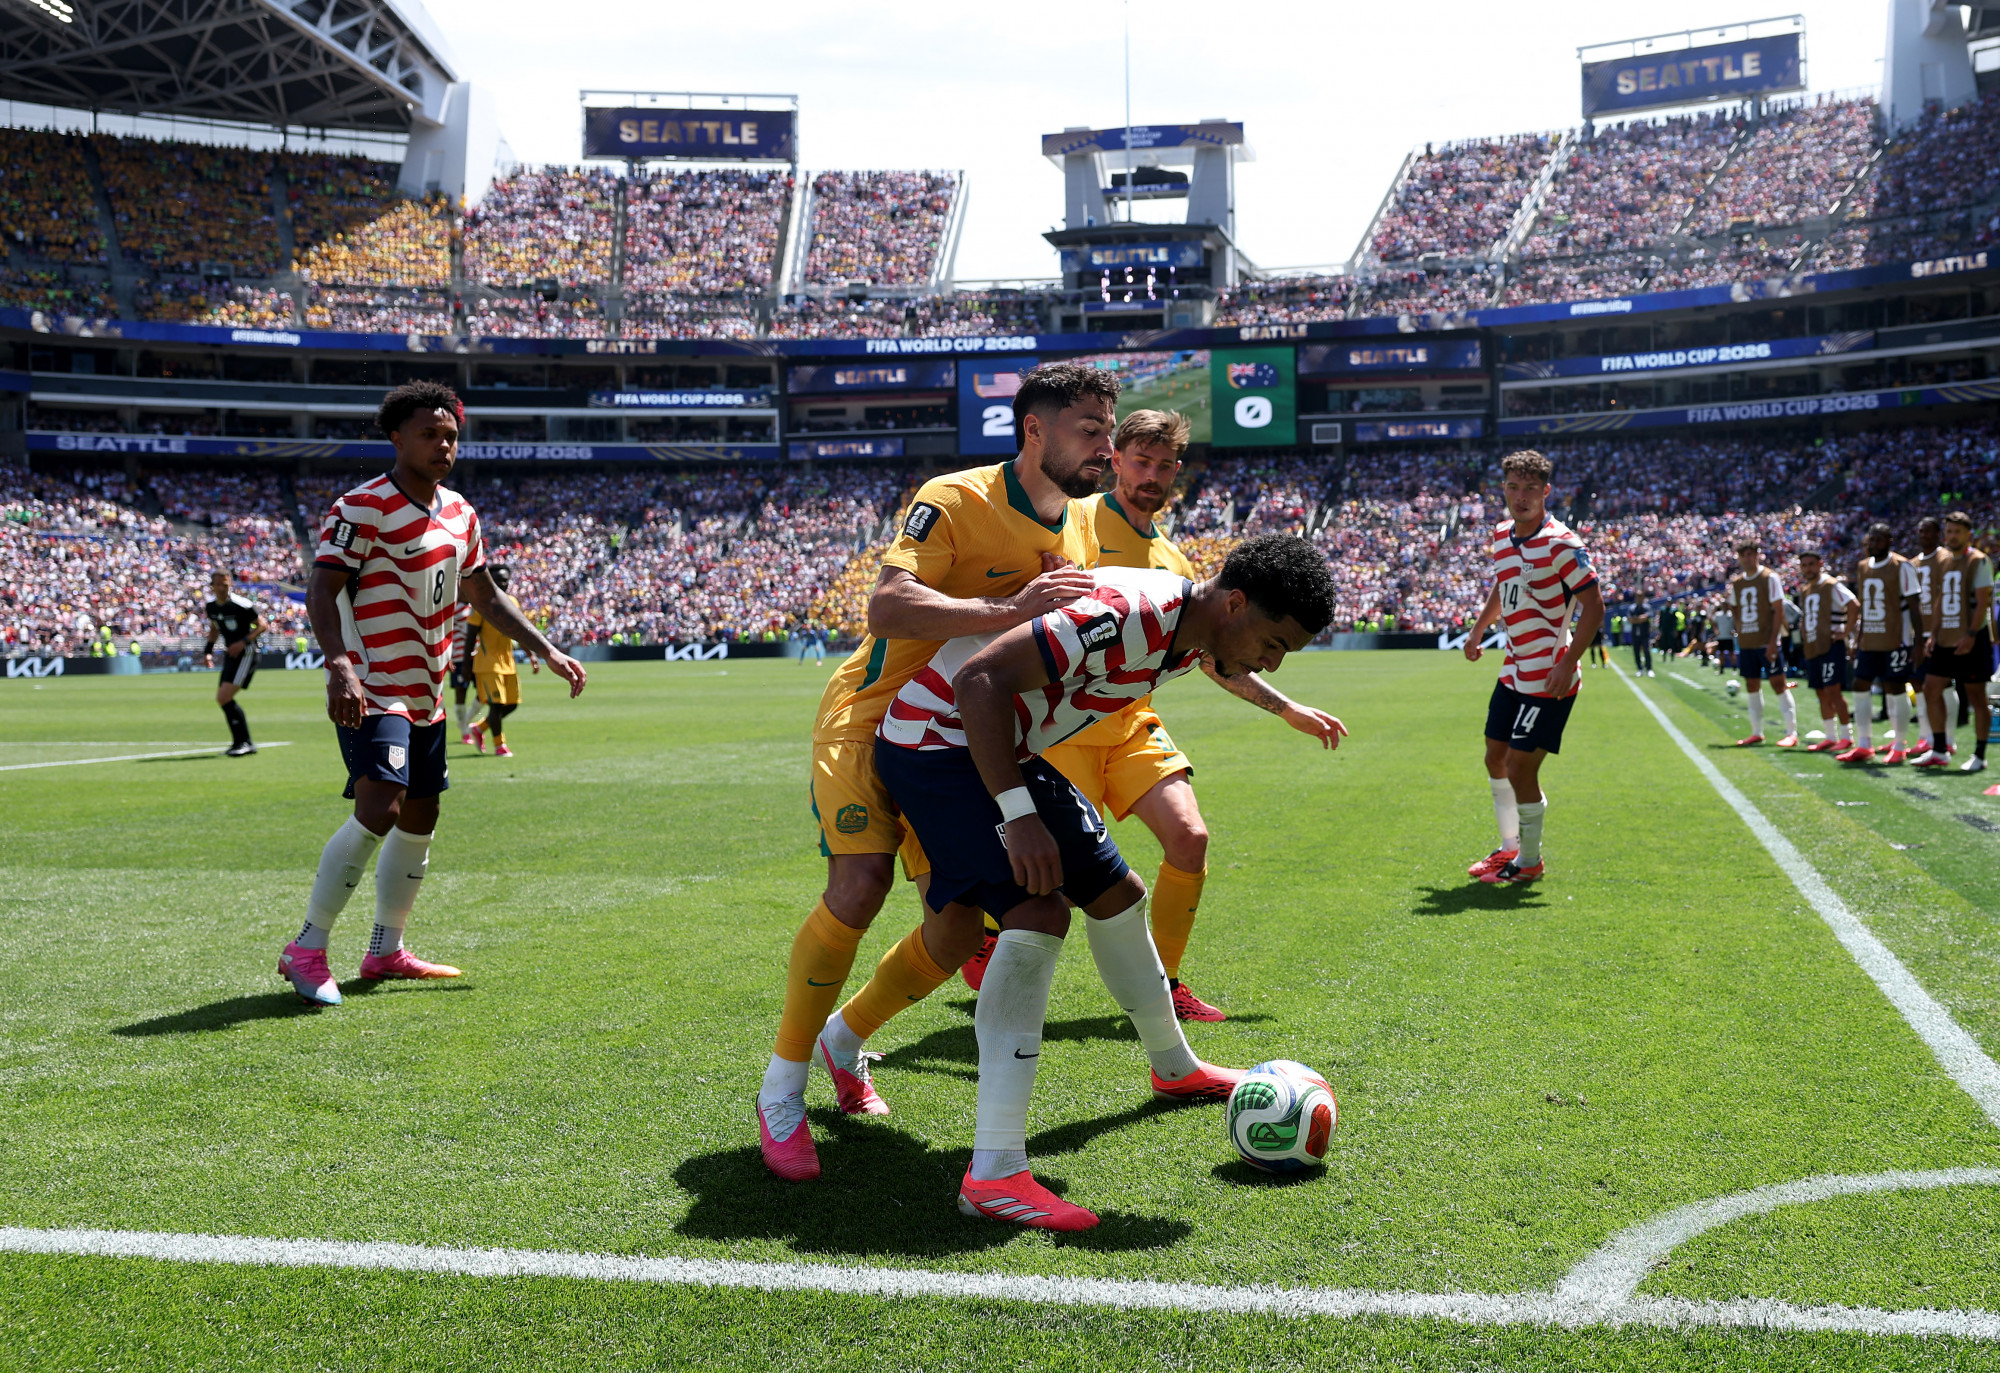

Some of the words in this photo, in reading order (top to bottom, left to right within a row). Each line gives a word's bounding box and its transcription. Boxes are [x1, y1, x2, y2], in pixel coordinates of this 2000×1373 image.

[1617, 51, 1762, 95] SEATTLE
[619, 119, 759, 145] SEATTLE
[1091, 247, 1169, 265] SEATTLE
[1911, 251, 1988, 278] SEATTLE
[1239, 324, 1308, 341] SEATTLE
[586, 340, 657, 353] SEATTLE
[866, 339, 900, 353] FIFA
[900, 338, 953, 352] WORLD
[954, 337, 984, 351] CUP
[984, 336, 1038, 350] 2026
[1349, 348, 1428, 365] SEATTLE
[1601, 357, 1634, 371] FIFA
[1634, 352, 1687, 369] WORLD
[1687, 348, 1718, 364] CUP
[1718, 343, 1771, 361] 2026
[834, 368, 906, 385] SEATTLE
[614, 394, 638, 405] FIFA
[639, 394, 681, 404] WORLD
[681, 394, 704, 404] CUP
[704, 394, 744, 404] 2026
[1687, 409, 1722, 423] FIFA
[1722, 403, 1784, 421] WORLD
[1785, 400, 1819, 416] CUP
[1820, 394, 1879, 412] 2026
[982, 404, 1015, 437] 2
[1234, 396, 1273, 429] 0
[1387, 423, 1449, 437] SEATTLE
[56, 436, 187, 453] SEATTLE
[456, 446, 499, 459] ORLD
[500, 446, 534, 459] CUP
[535, 447, 593, 460] 2026
[818, 443, 873, 455] SEATTLE
[433, 570, 445, 605] 8
[1503, 582, 1519, 610] 14
[665, 643, 728, 661] KIA
[1889, 650, 1908, 667] 22
[7, 656, 64, 679] KIA
[1822, 662, 1835, 678] 15
[1513, 703, 1541, 733] 14
